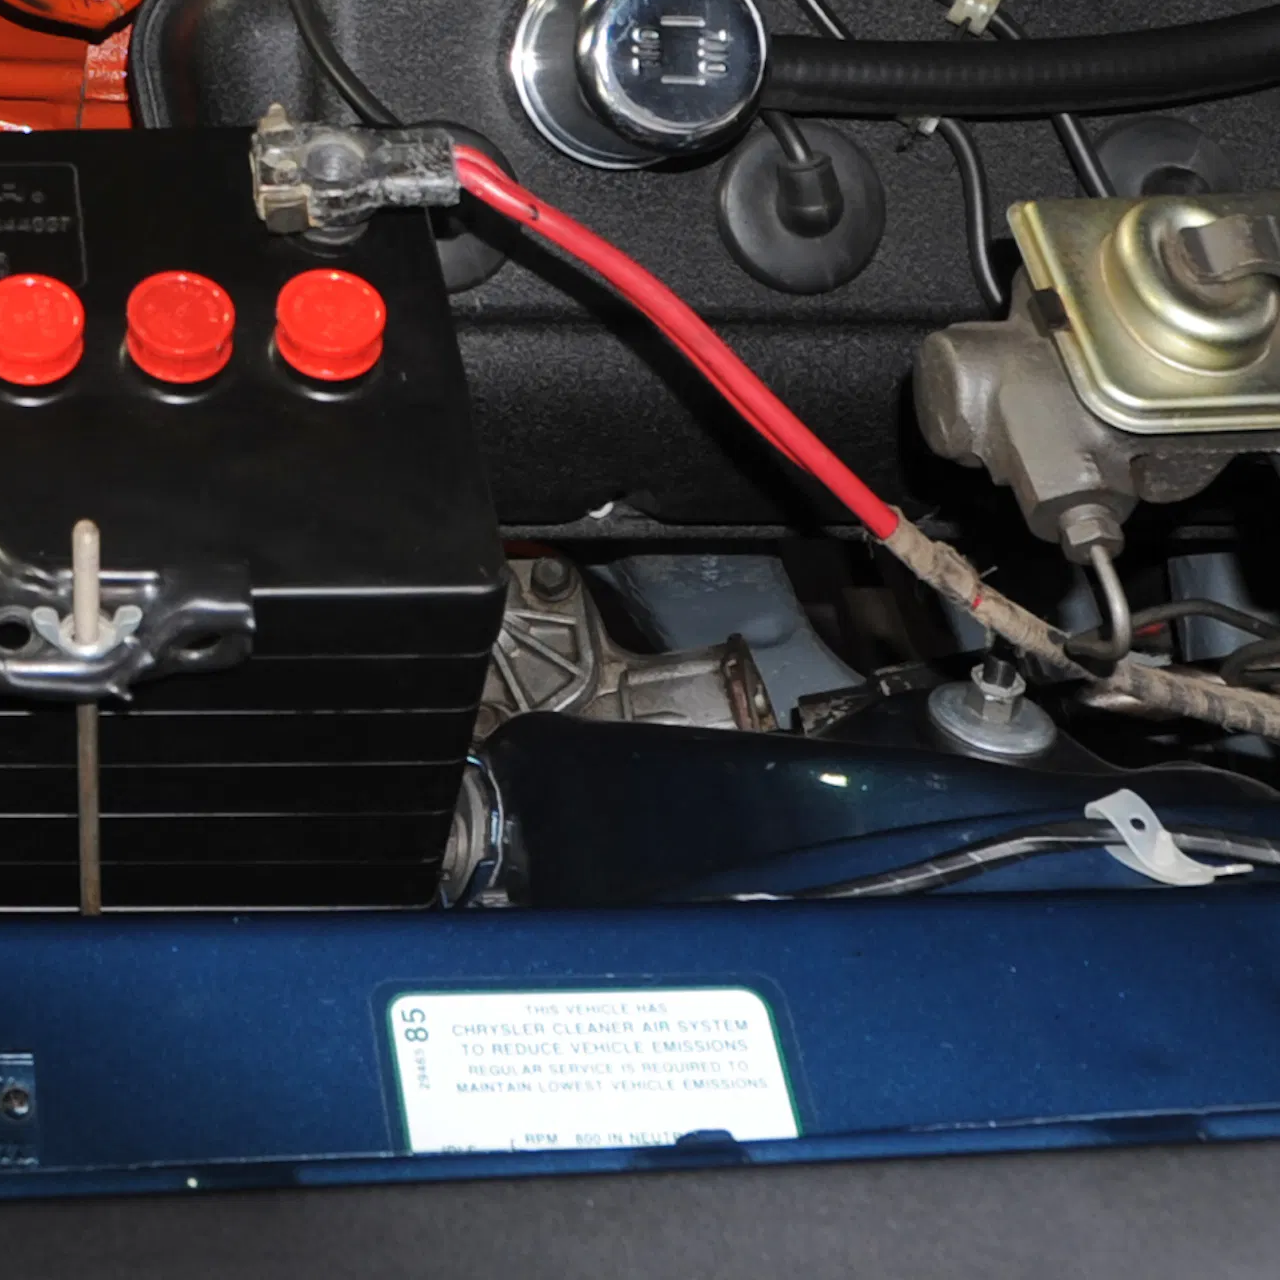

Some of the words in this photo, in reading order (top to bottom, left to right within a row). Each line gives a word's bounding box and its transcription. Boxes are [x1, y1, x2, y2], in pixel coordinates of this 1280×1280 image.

[524, 1004, 560, 1016] THIS
[566, 1003, 629, 1016] VEHICLE
[635, 1002, 668, 1015] HAS
[401, 1007, 429, 1043] 85
[451, 1022, 546, 1037] CHRYSLER
[552, 1021, 634, 1036] CLEANER
[642, 1020, 671, 1033] AIR
[677, 1019, 749, 1033] SYSTEM
[460, 1043, 485, 1057] TO
[491, 1042, 564, 1056] REDUCE
[569, 1040, 645, 1055] VEHICLE
[651, 1039, 749, 1053] EMISSIONS
[468, 1063, 543, 1077] REGULAR
[548, 1062, 614, 1075] SERVICE
[640, 1060, 721, 1074] REQUIRED
[728, 1060, 749, 1073] TO
[455, 1081, 533, 1094] MAINTAIN
[539, 1079, 602, 1094] LOWEST
[611, 1078, 676, 1092] VEHICLE
[682, 1077, 769, 1091] EMISSIONS
[524, 1132, 558, 1145] RPM
[629, 1131, 682, 1146] NEUTR
